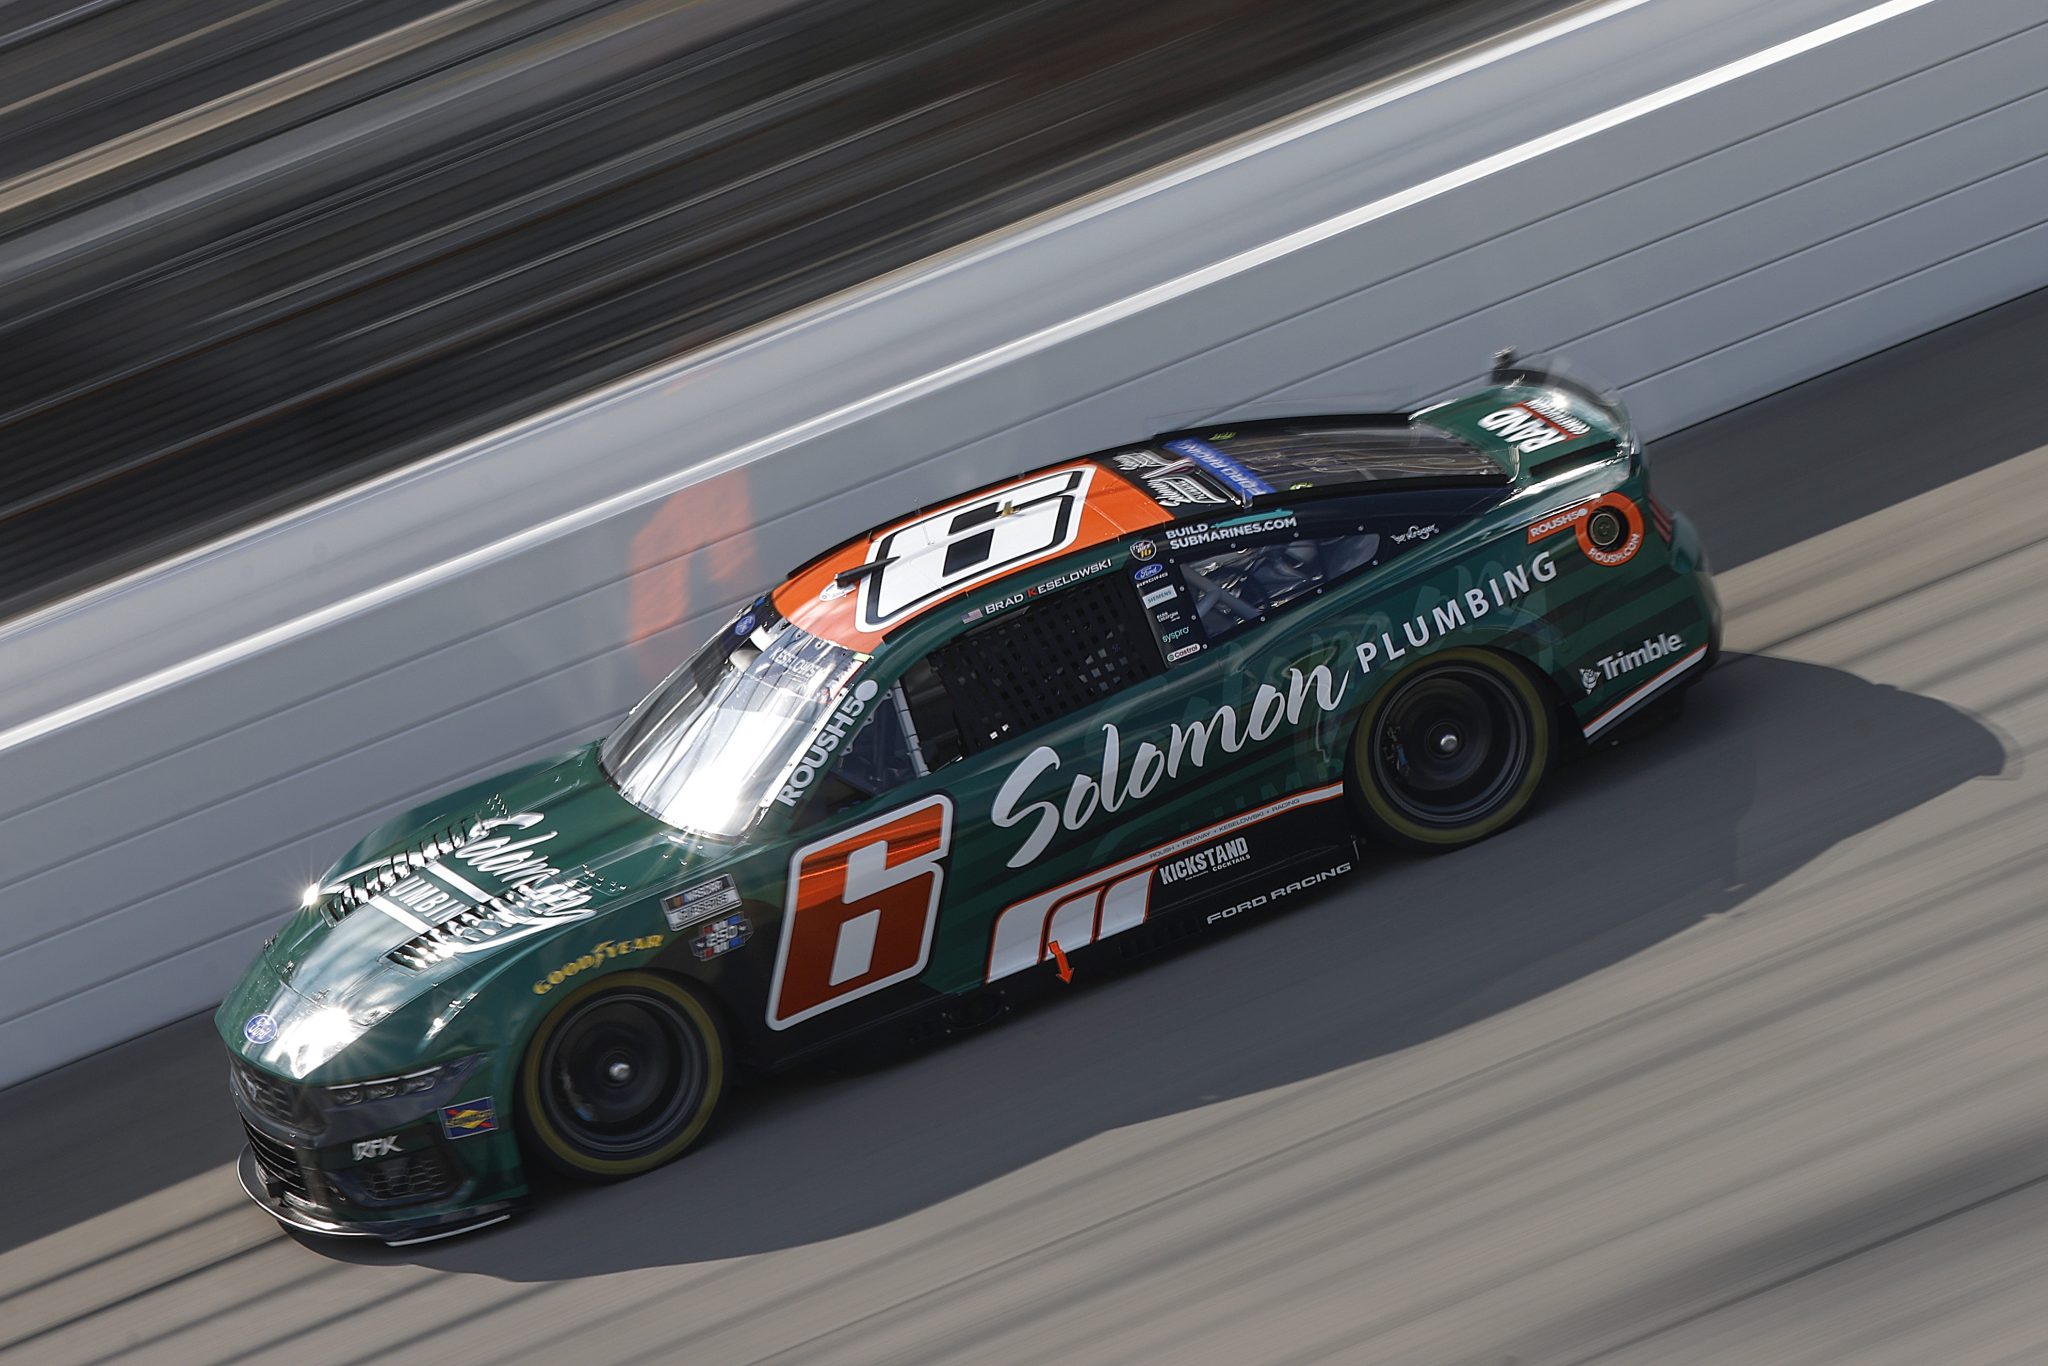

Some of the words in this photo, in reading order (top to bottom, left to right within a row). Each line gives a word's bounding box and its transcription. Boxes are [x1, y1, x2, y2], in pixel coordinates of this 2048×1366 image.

[1477, 407, 1569, 453] RAND
[856, 464, 1097, 633] 6
[1165, 523, 1209, 540] BUILD
[1170, 516, 1297, 550] SUBMARINES.COM
[985, 594, 1024, 615] BRAD
[1027, 558, 1112, 597] KESELOWSKI
[1174, 645, 1199, 659] Castrol
[1597, 633, 1683, 680] Trimble
[992, 664, 1350, 869] Solomon
[1356, 551, 1560, 673] PLUMBING
[1150, 845, 1175, 859] ROUSH
[1182, 831, 1211, 847] FENWAY
[1219, 811, 1264, 832] KESELOWSKI
[1272, 798, 1300, 812] RACING
[1160, 837, 1249, 885] KICKSTAND
[1212, 854, 1251, 872] COCKTAILS
[765, 794, 954, 1031] 6
[1207, 896, 1268, 924] FORD
[1270, 862, 1351, 900] RACING
[533, 934, 664, 995] GOODYEAR
